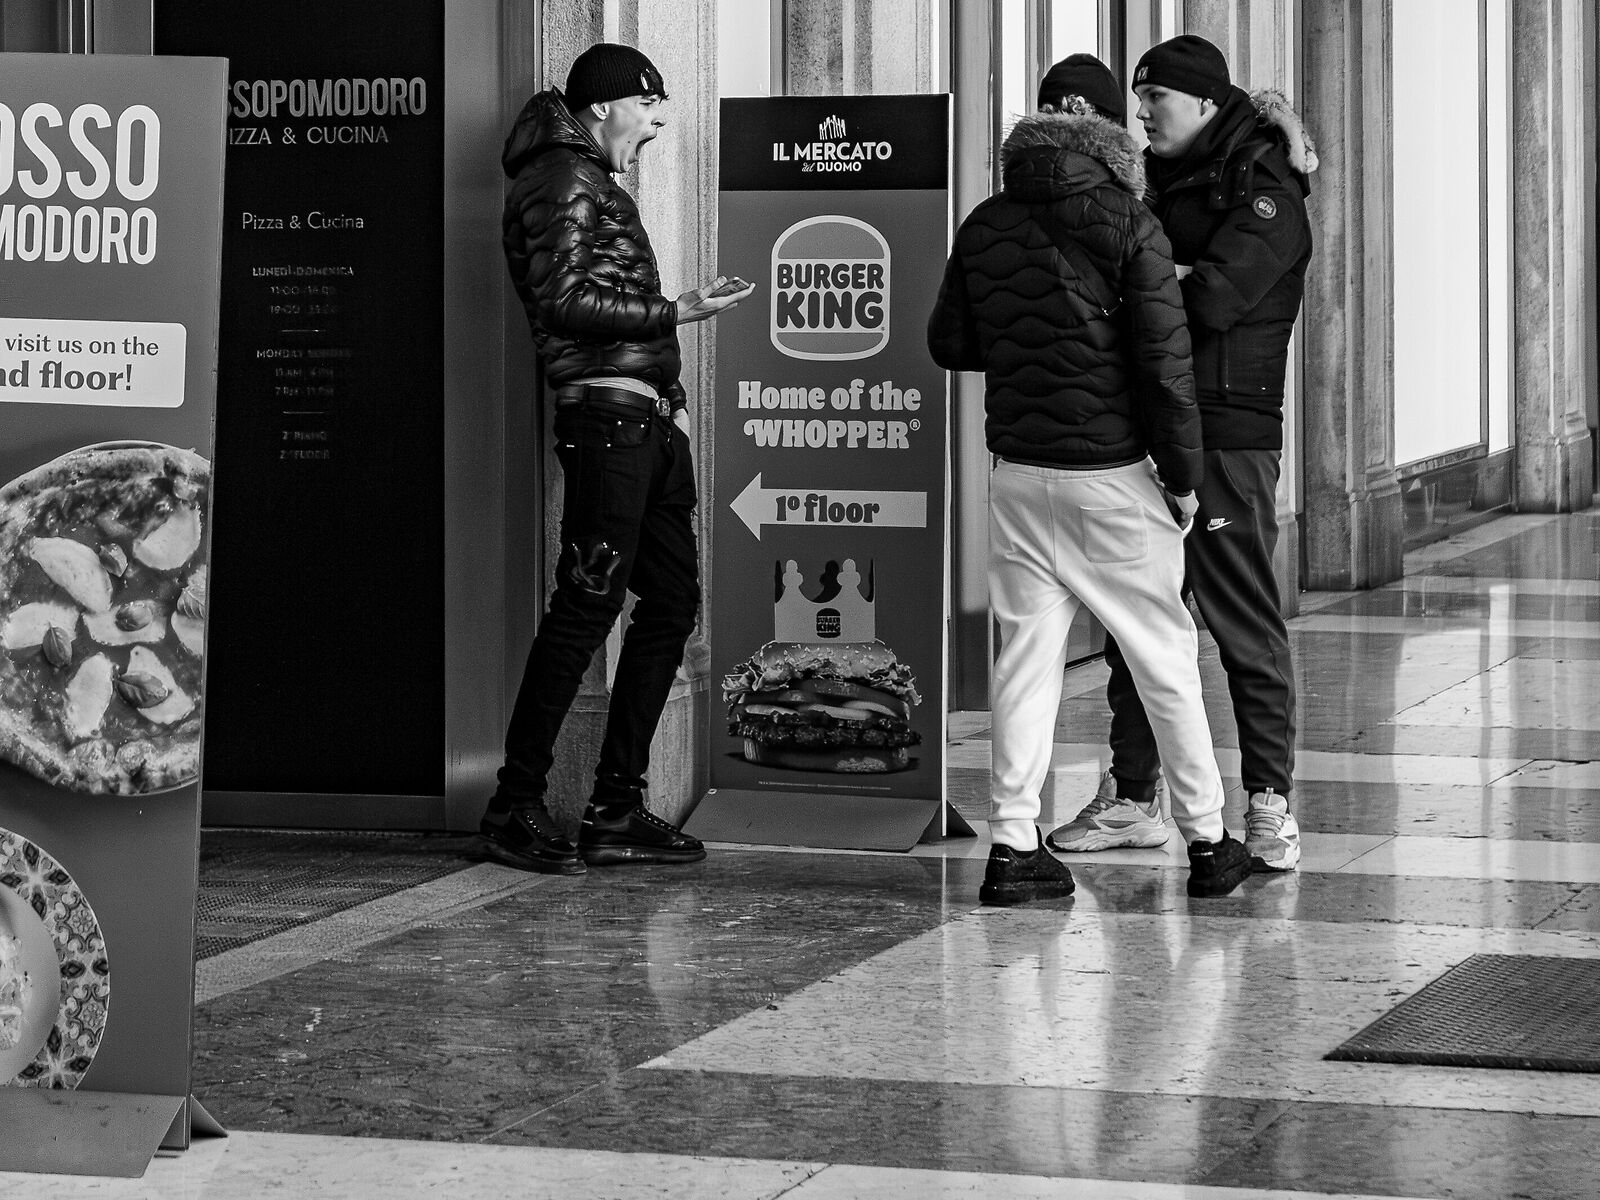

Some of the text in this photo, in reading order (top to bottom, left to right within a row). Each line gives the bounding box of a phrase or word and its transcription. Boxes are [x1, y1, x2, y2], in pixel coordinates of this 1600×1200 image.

[226, 77, 427, 118] SOPOMODORO
[282, 127, 297, 145] &
[307, 126, 389, 144] CUCINA
[773, 141, 893, 162] IL MERCATO
[816, 161, 862, 172] DUOMO
[242, 211, 364, 230] Pizza & Cucina
[777, 263, 884, 290] BURGER
[777, 291, 884, 330] KING
[5, 333, 159, 356] visit us on the
[39, 360, 133, 391] floor!
[738, 378, 921, 411] Home of the
[804, 492, 880, 524] floor
[816, 624, 841, 632] KING
